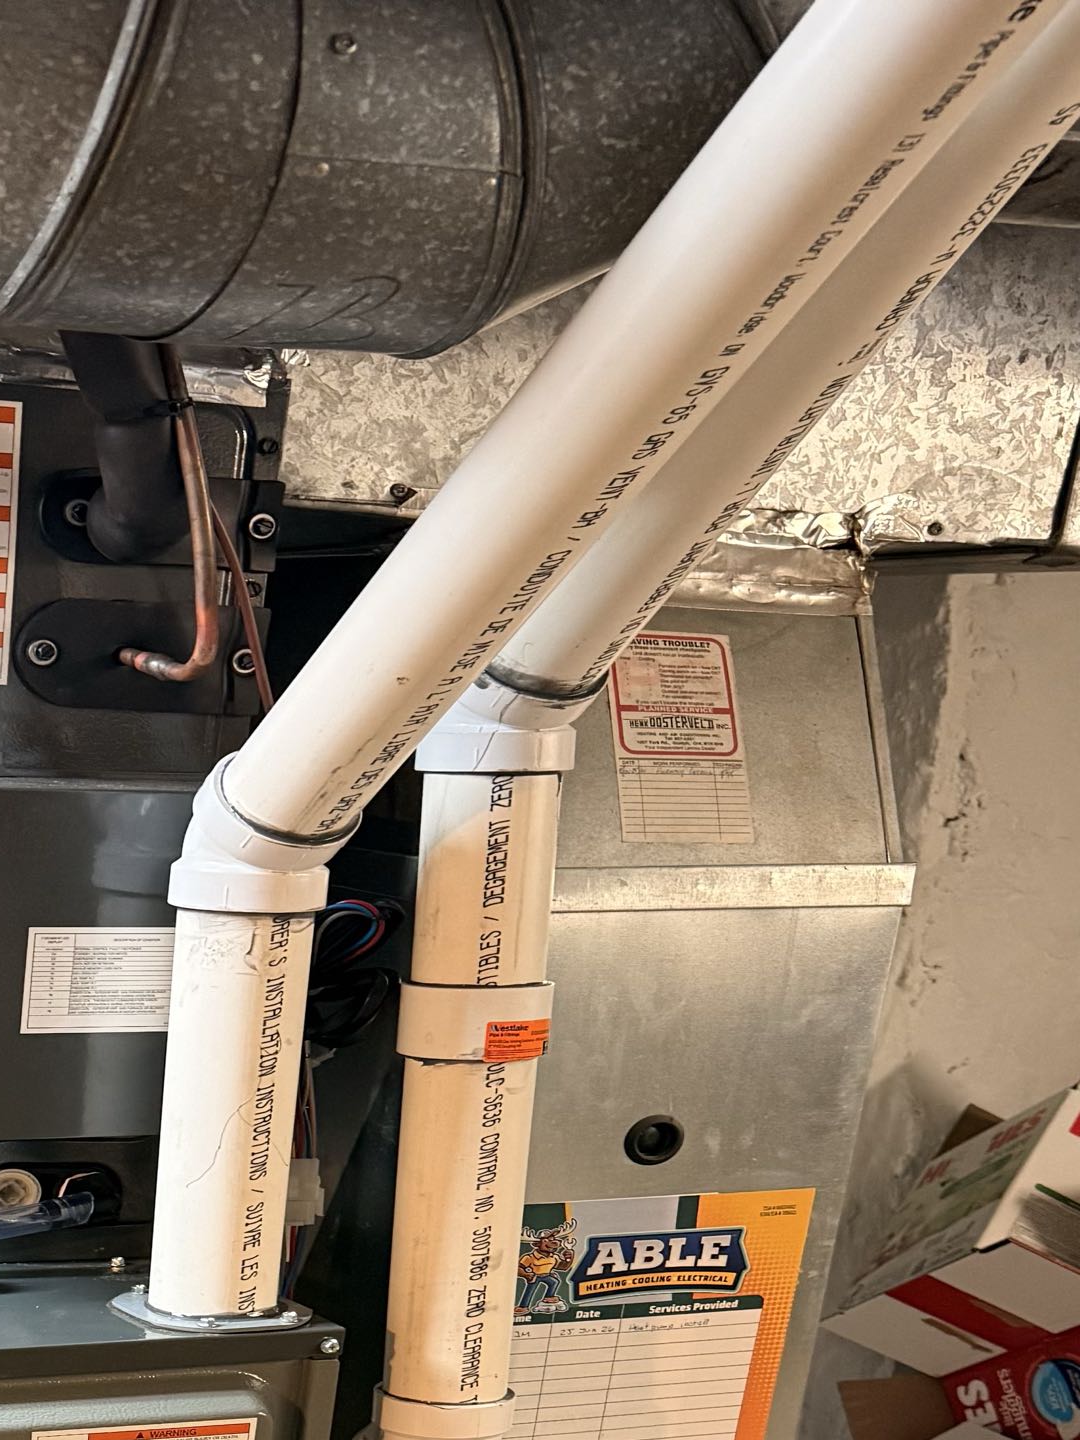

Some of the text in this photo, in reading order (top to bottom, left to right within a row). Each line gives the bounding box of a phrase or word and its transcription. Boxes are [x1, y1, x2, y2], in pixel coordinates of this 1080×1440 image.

[876, 271, 934, 331] CANADA
[663, 366, 729, 425] GVS-65
[632, 431, 674, 460] GAS
[571, 466, 645, 529] VENT-BH
[499, 550, 572, 615] CONDUITE
[480, 618, 513, 637] DE
[662, 640, 710, 648] TROUBLE?
[450, 640, 495, 673] MISE
[438, 676, 462, 687] A
[402, 685, 453, 728] L'AIR
[371, 725, 412, 766] LIBRE
[351, 768, 384, 790] DES
[489, 775, 513, 812] ZERO
[482, 818, 511, 908] DEGAGEMENT
[258, 974, 286, 1077] INSTALLATION
[248, 1081, 276, 1182] INSTRUCTIONS
[476, 1133, 500, 1191] CONTROL
[243, 1202, 264, 1251] SUIVRE
[473, 1195, 495, 1221] NO.
[241, 1255, 259, 1281] LES
[469, 1225, 492, 1281] 5007586
[586, 1234, 732, 1276] ABLE
[467, 1286, 487, 1318] ZERO
[586, 1274, 729, 1292] HEATING COOLING ELECTRICAL
[575, 1300, 739, 1319] Date Services Provided
[460, 1321, 484, 1392] CLEARANCE
[150, 1428, 197, 1439] WARNING
